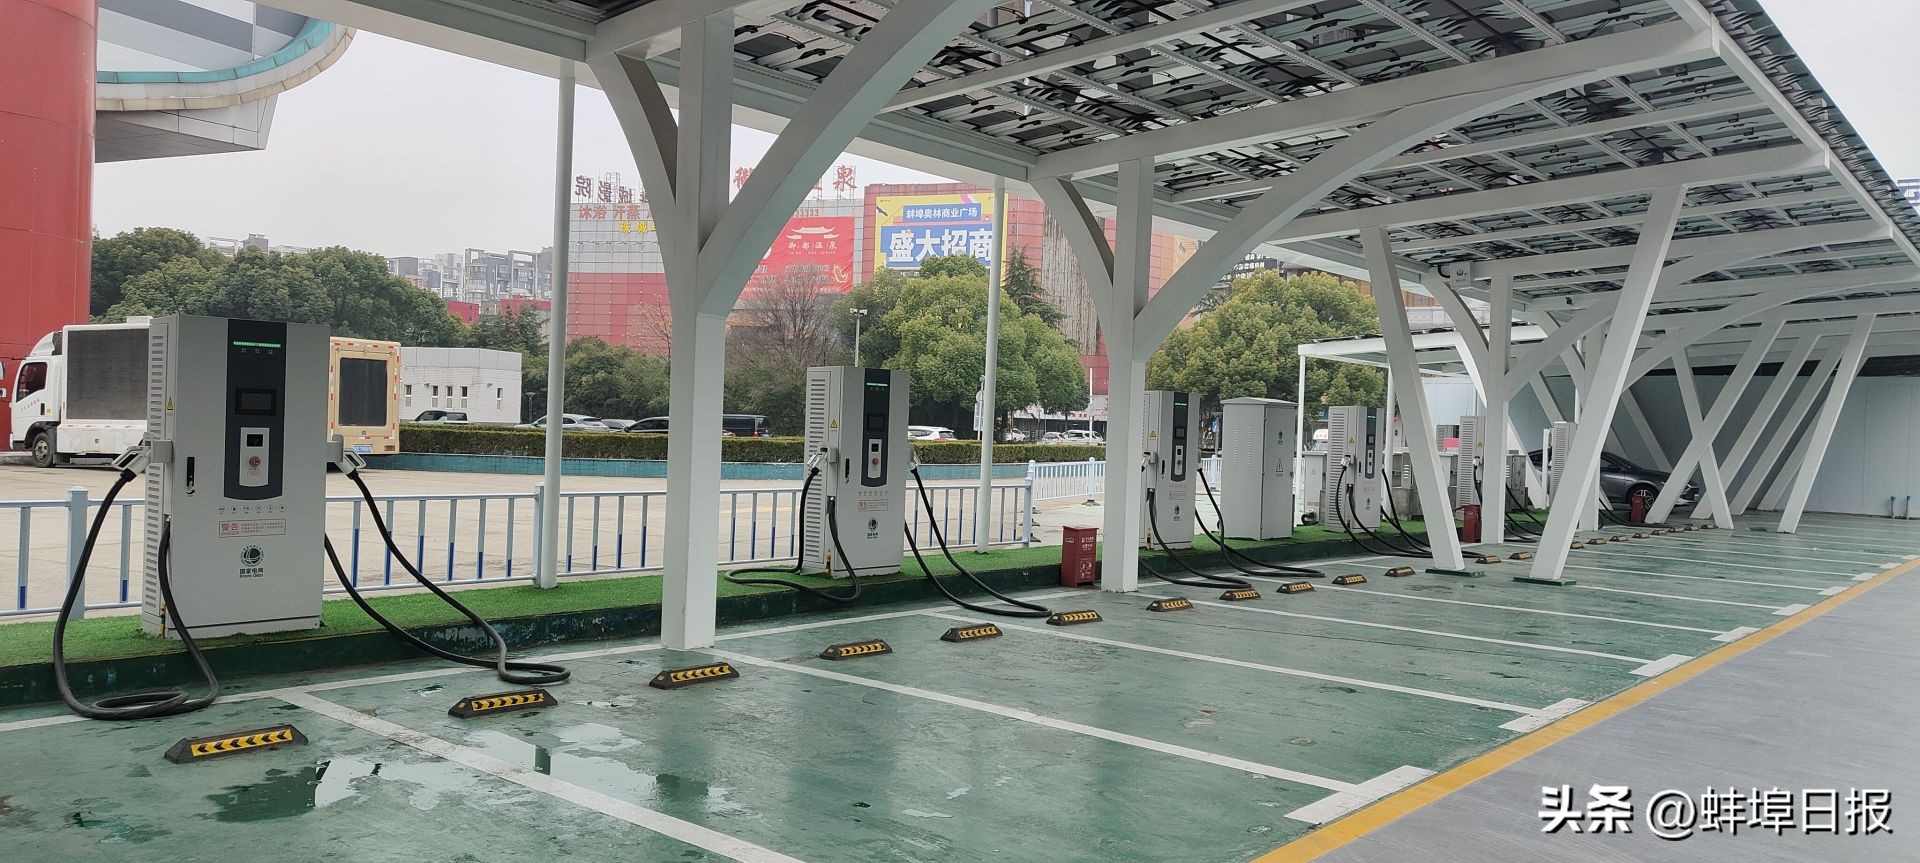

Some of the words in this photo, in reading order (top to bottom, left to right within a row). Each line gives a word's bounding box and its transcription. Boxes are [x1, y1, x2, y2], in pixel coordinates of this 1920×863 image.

[906, 207, 978, 219] 蚌埠奥林商业广场
[889, 228, 993, 263] 盛大招商
